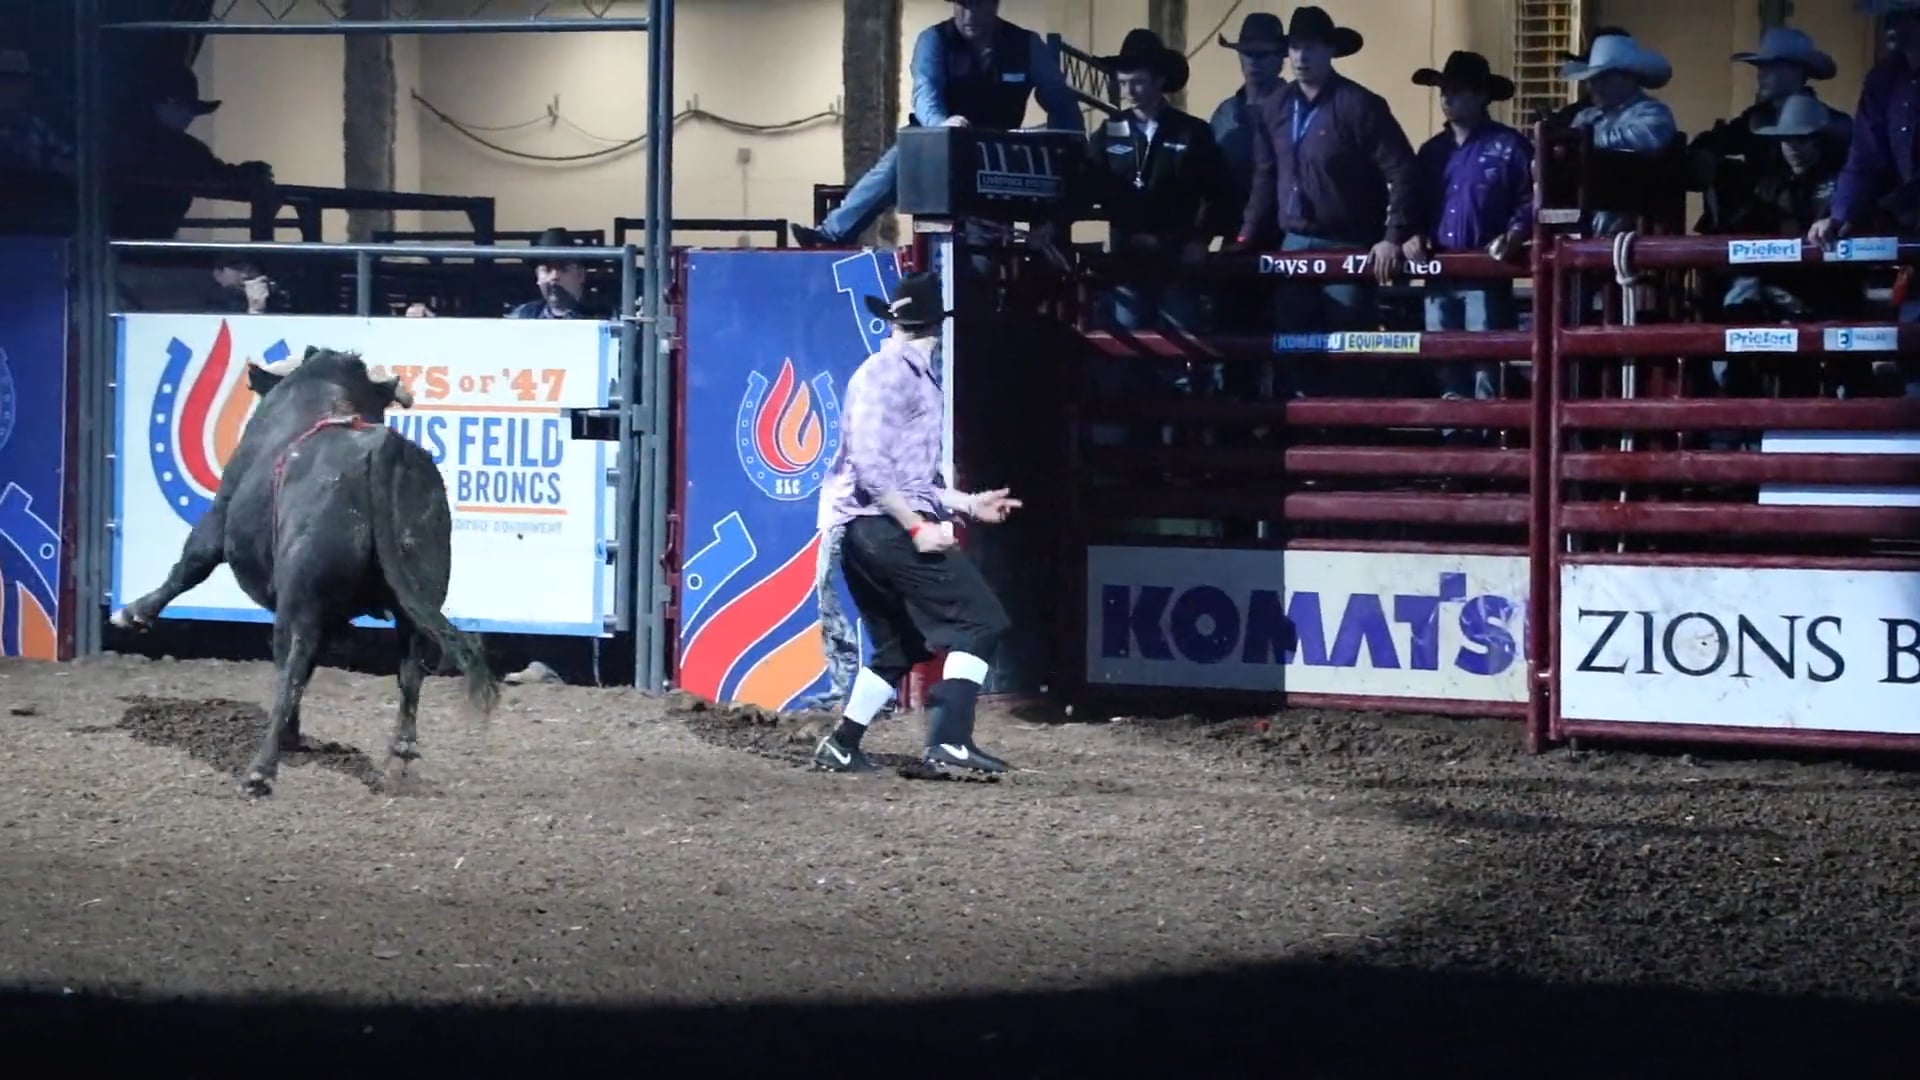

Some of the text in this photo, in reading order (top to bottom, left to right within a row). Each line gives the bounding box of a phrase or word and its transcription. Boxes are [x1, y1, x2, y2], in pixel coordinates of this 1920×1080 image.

[1259, 255, 1307, 277] Days
[1313, 260, 1327, 274] o
[1342, 255, 1368, 274] 47
[1349, 334, 1416, 350] EQUIPMENT
[458, 417, 564, 467] FEILD
[457, 470, 561, 504] BRONCS
[775, 479, 800, 494] SLC
[1101, 572, 1530, 676] KOMATS
[1576, 606, 1846, 683] ZIONS
